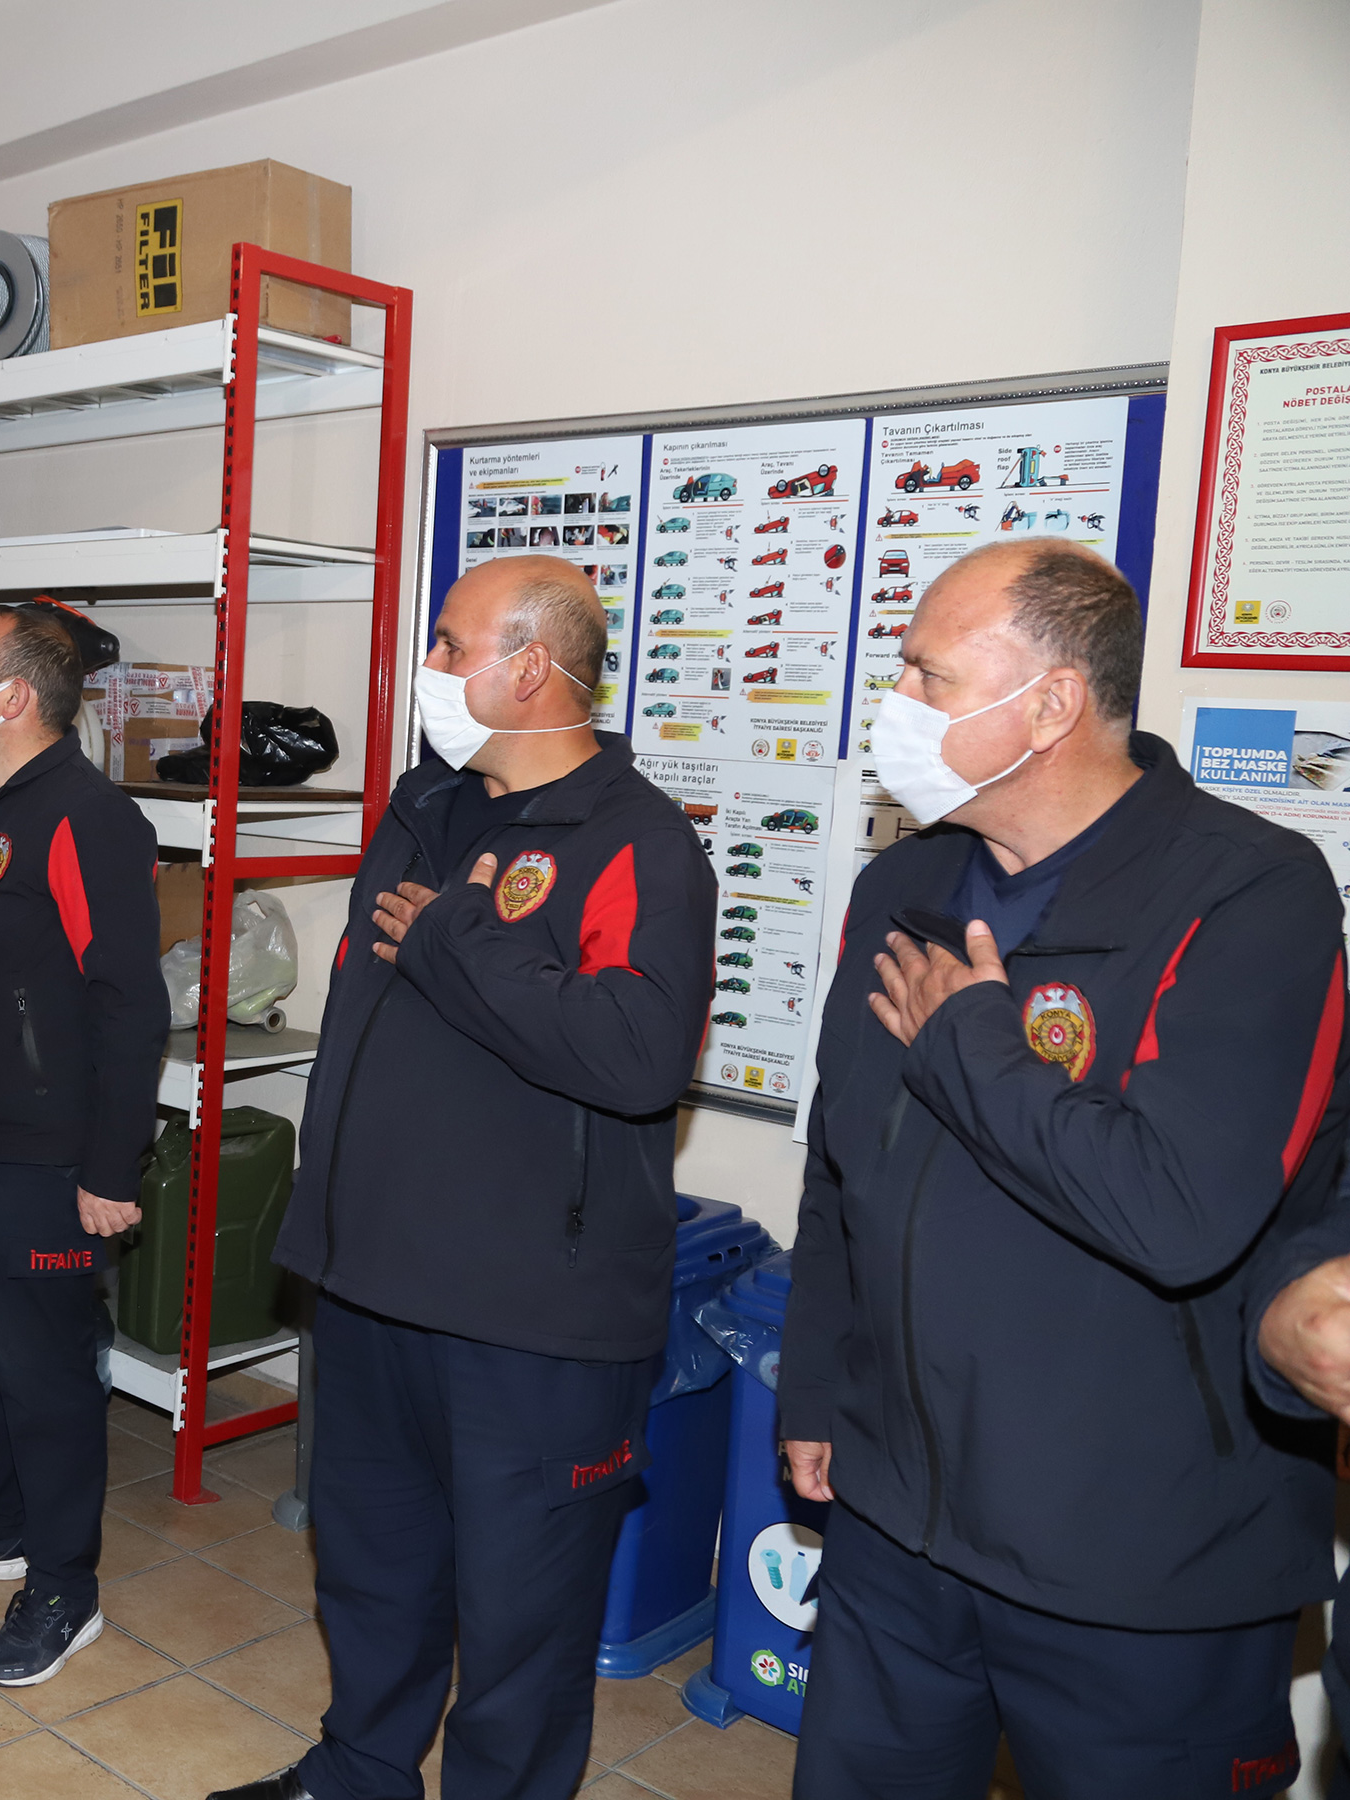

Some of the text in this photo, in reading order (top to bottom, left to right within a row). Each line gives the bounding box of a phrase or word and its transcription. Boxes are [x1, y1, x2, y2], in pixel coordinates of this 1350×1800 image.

[139, 212, 150, 310] FILTER
[1281, 364, 1320, 372] BÜYÜKŞEHİR
[1283, 398, 1317, 408] NÖBET
[883, 421, 985, 436] Tavanın Çıkartılması
[663, 442, 689, 452] Kapının
[469, 453, 540, 465] Kurtarma yöntemleri
[998, 455, 1011, 463] roof
[479, 466, 519, 477] ekipmanları
[1202, 746, 1288, 761] TOPLUMDA
[639, 758, 719, 773] Ağır yük taşıtları
[1201, 758, 1287, 772] BEZ MASKE
[653, 771, 679, 782] kapılı
[682, 775, 716, 785] araçlar
[1200, 769, 1286, 783] KULLANIMI
[1040, 1010, 1072, 1021] KONYA
[737, 1045, 767, 1055] BÜYÜKŞEHİR
[768, 1051, 795, 1060] BELEDİYESİ
[30, 1249, 92, 1270] İTFAİYE
